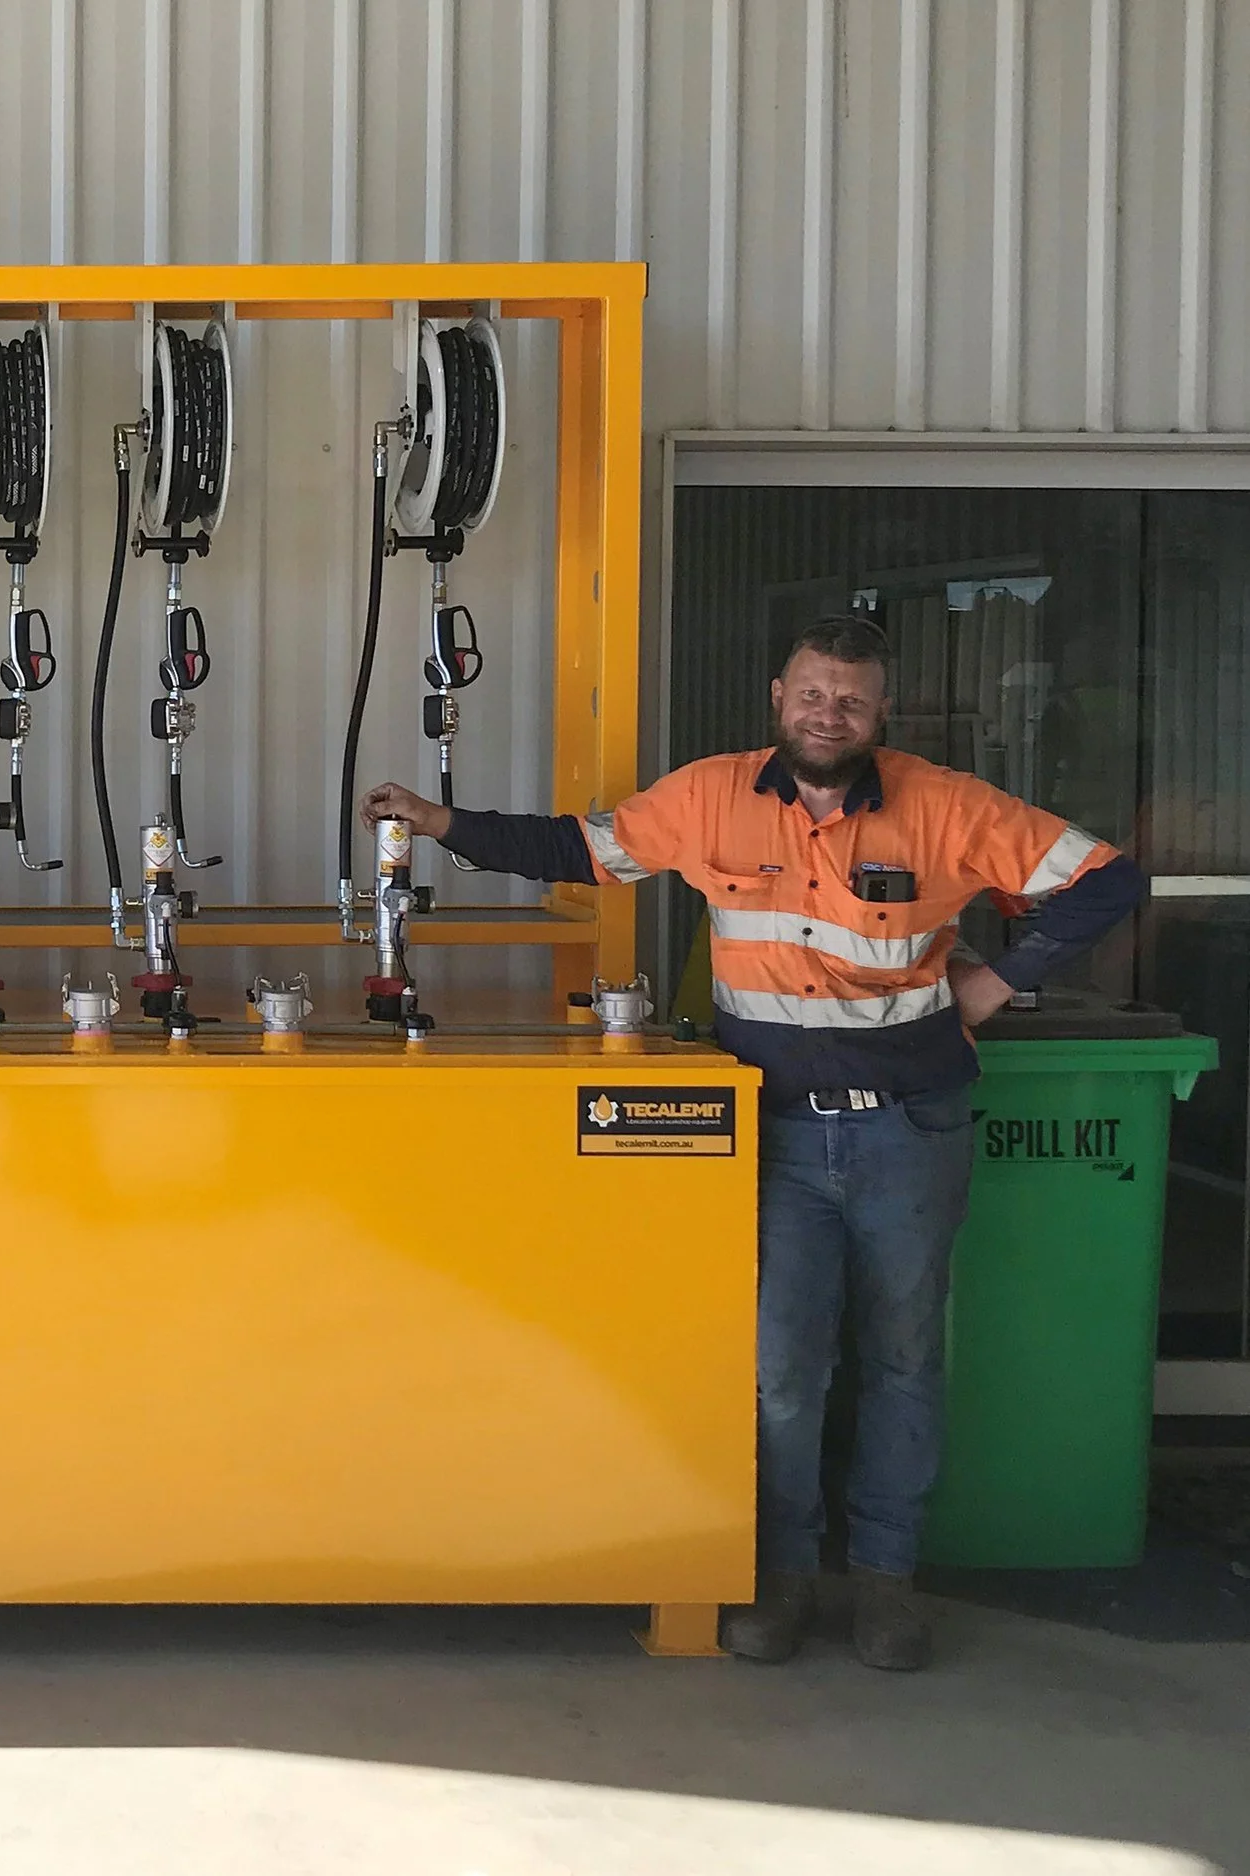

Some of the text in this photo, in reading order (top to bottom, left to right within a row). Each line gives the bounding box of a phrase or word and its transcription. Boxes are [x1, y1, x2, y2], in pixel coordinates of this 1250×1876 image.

[623, 1103, 725, 1117] TECALEMIT
[615, 1139, 693, 1148] tecalemit.com.au
[986, 1119, 1121, 1158] SPILL KIT
